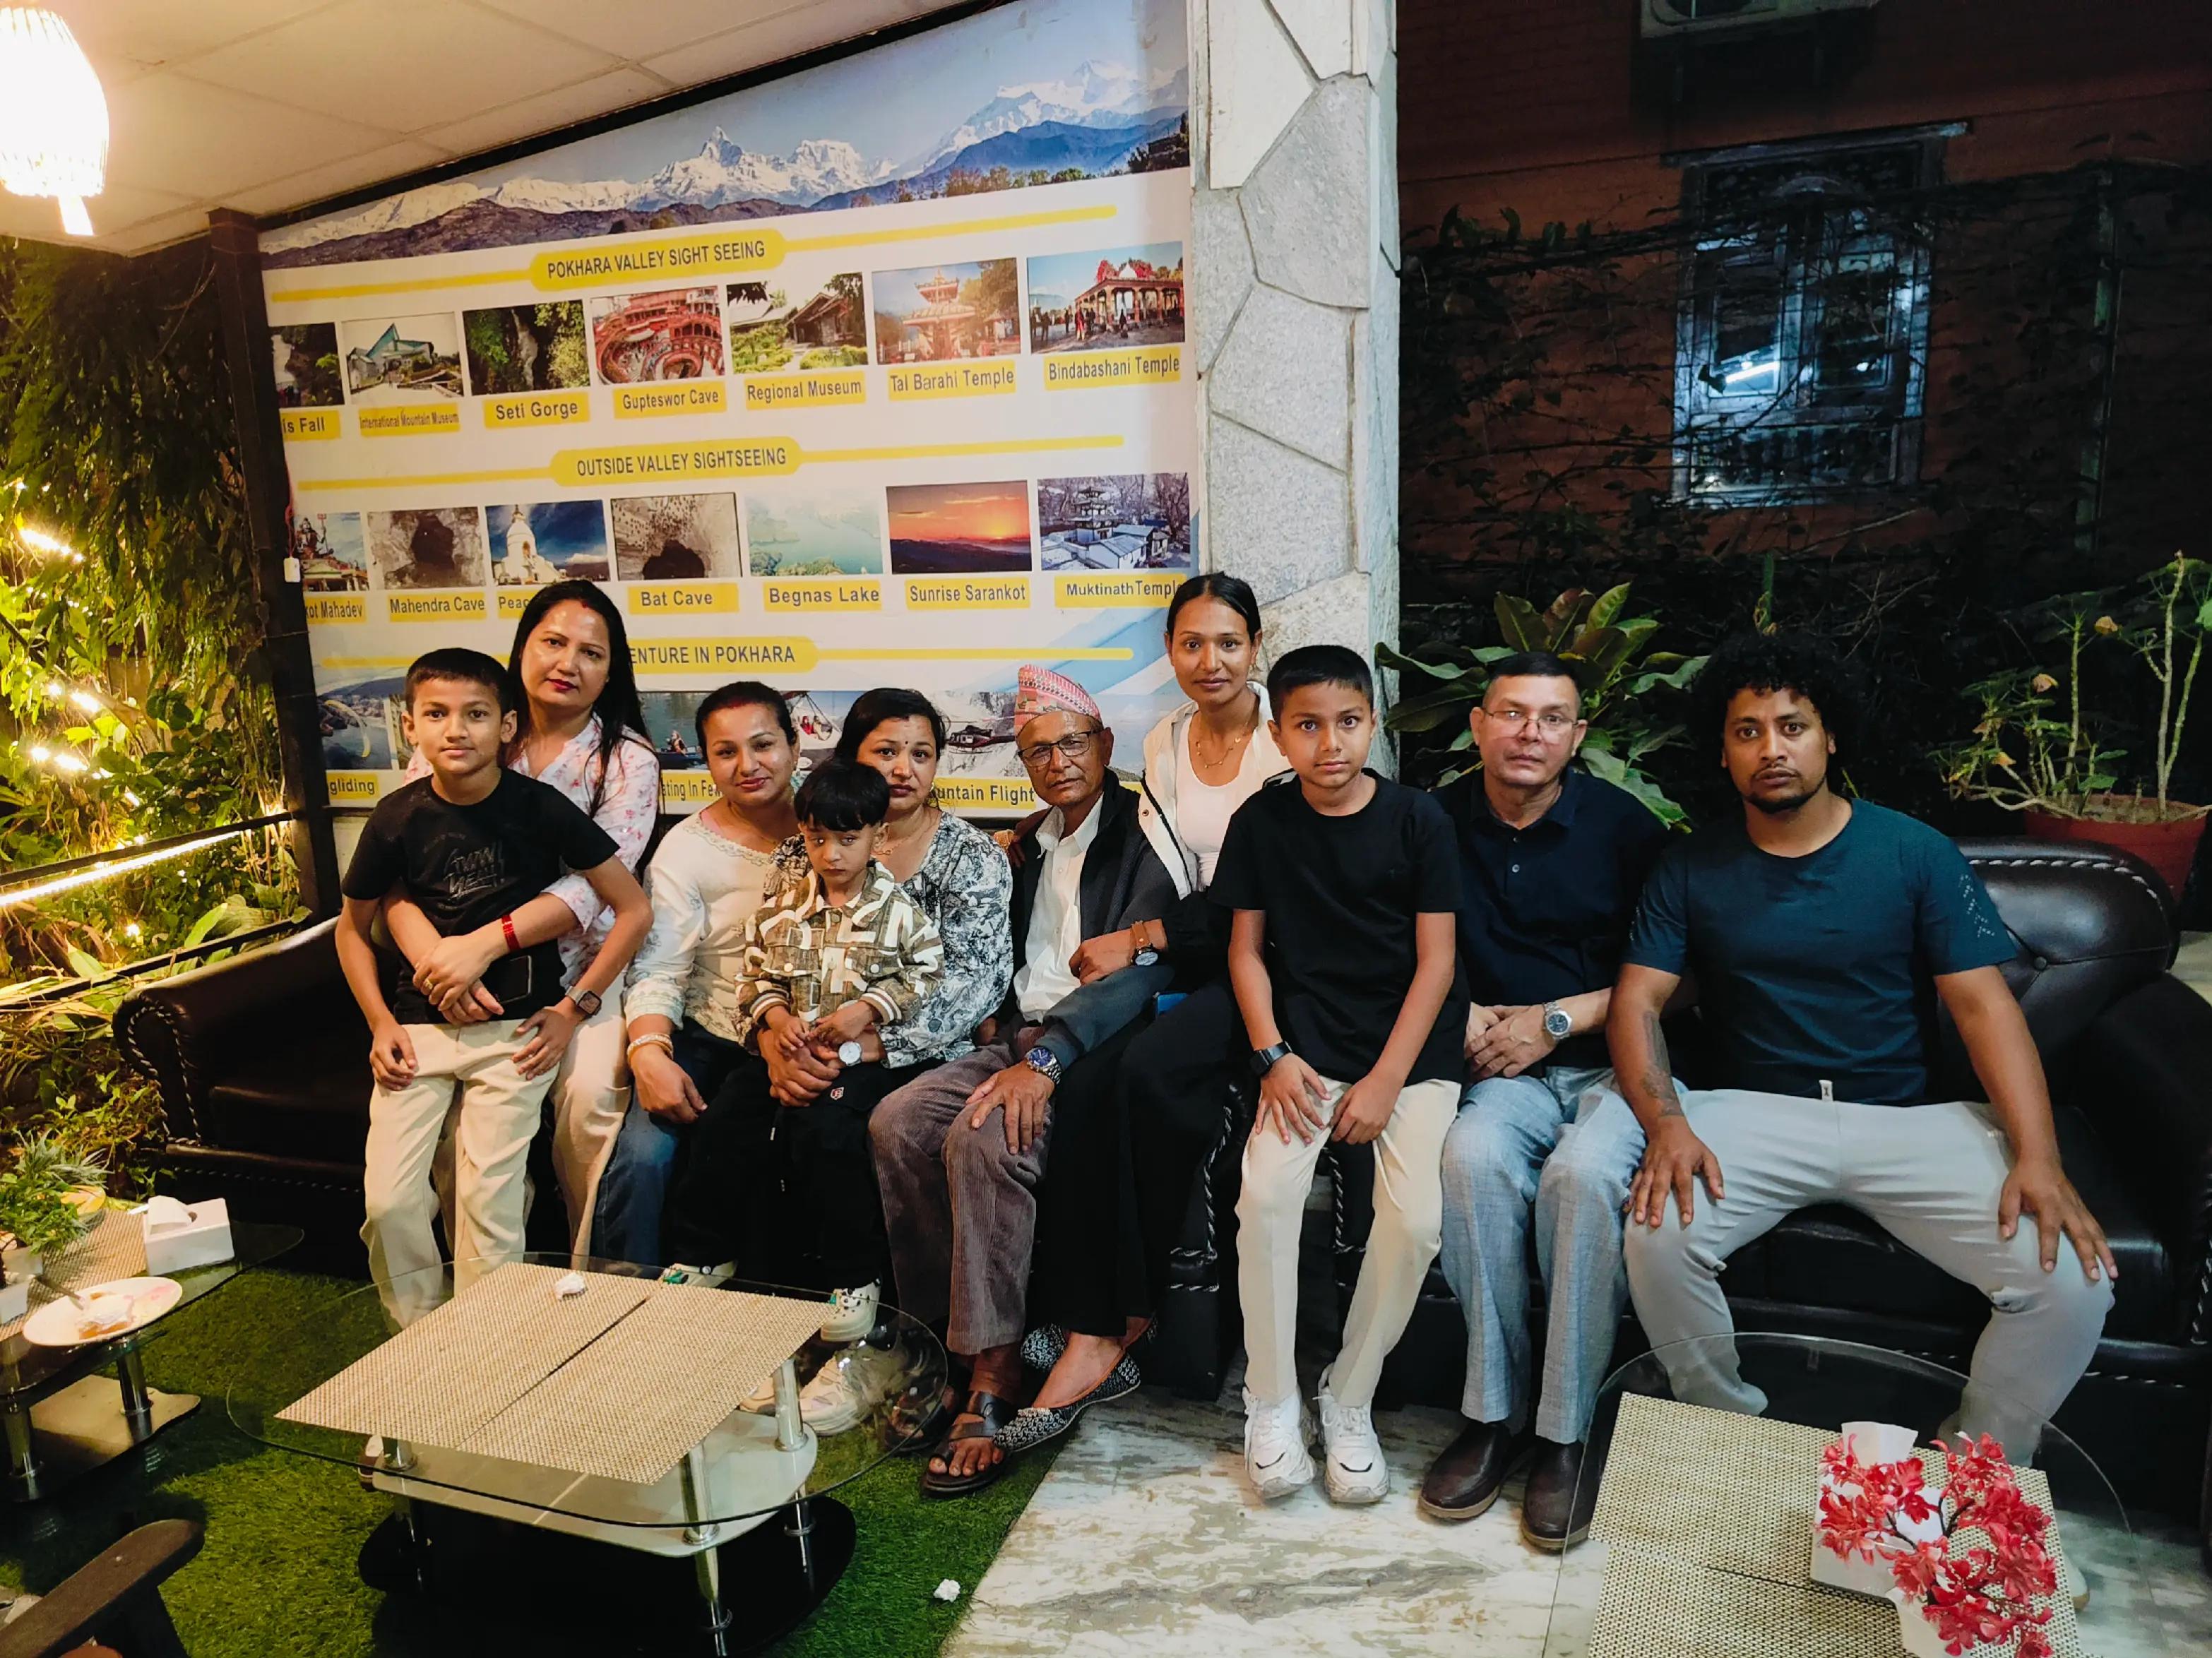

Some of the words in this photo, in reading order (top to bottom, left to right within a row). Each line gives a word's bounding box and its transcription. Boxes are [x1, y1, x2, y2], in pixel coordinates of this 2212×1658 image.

[547, 256, 612, 278] POKHARA
[614, 250, 665, 272] VALLEY
[669, 246, 709, 266] SIGHT
[713, 240, 765, 261] SEEING
[1049, 357, 1131, 381] Bindabashani
[1135, 353, 1179, 377] Temple
[889, 374, 910, 392] Tal
[912, 372, 958, 390] Barahi
[962, 366, 1014, 388] Temple
[623, 393, 686, 412] Gupteswor
[689, 389, 719, 405] Cave
[747, 381, 804, 404] Regional
[807, 380, 862, 397] Museum
[496, 402, 525, 420] Seti
[530, 401, 578, 419] Gorge
[299, 417, 325, 433] Fall
[359, 415, 400, 429] International
[400, 412, 430, 427] Mountain
[431, 412, 459, 424] Museum
[577, 456, 634, 477] OUTSIDE
[636, 453, 689, 472] VALLEY
[694, 447, 786, 470] SIGHTSEEING
[641, 591, 667, 607] Bat
[673, 590, 713, 606] Cave
[769, 588, 833, 607] Begnas
[839, 586, 879, 602] Lake
[910, 585, 961, 602] Sunrise
[965, 583, 1025, 602] Sarankot
[1066, 582, 1134, 596] Muktinath
[1135, 580, 1181, 600] Templ
[320, 600, 362, 619] Mahadev
[389, 597, 451, 614] Mahendra
[453, 596, 485, 612] Cave
[694, 646, 710, 664] IN
[715, 645, 795, 663] POKHARA
[688, 779, 698, 797] In
[989, 785, 1035, 806] Flight
